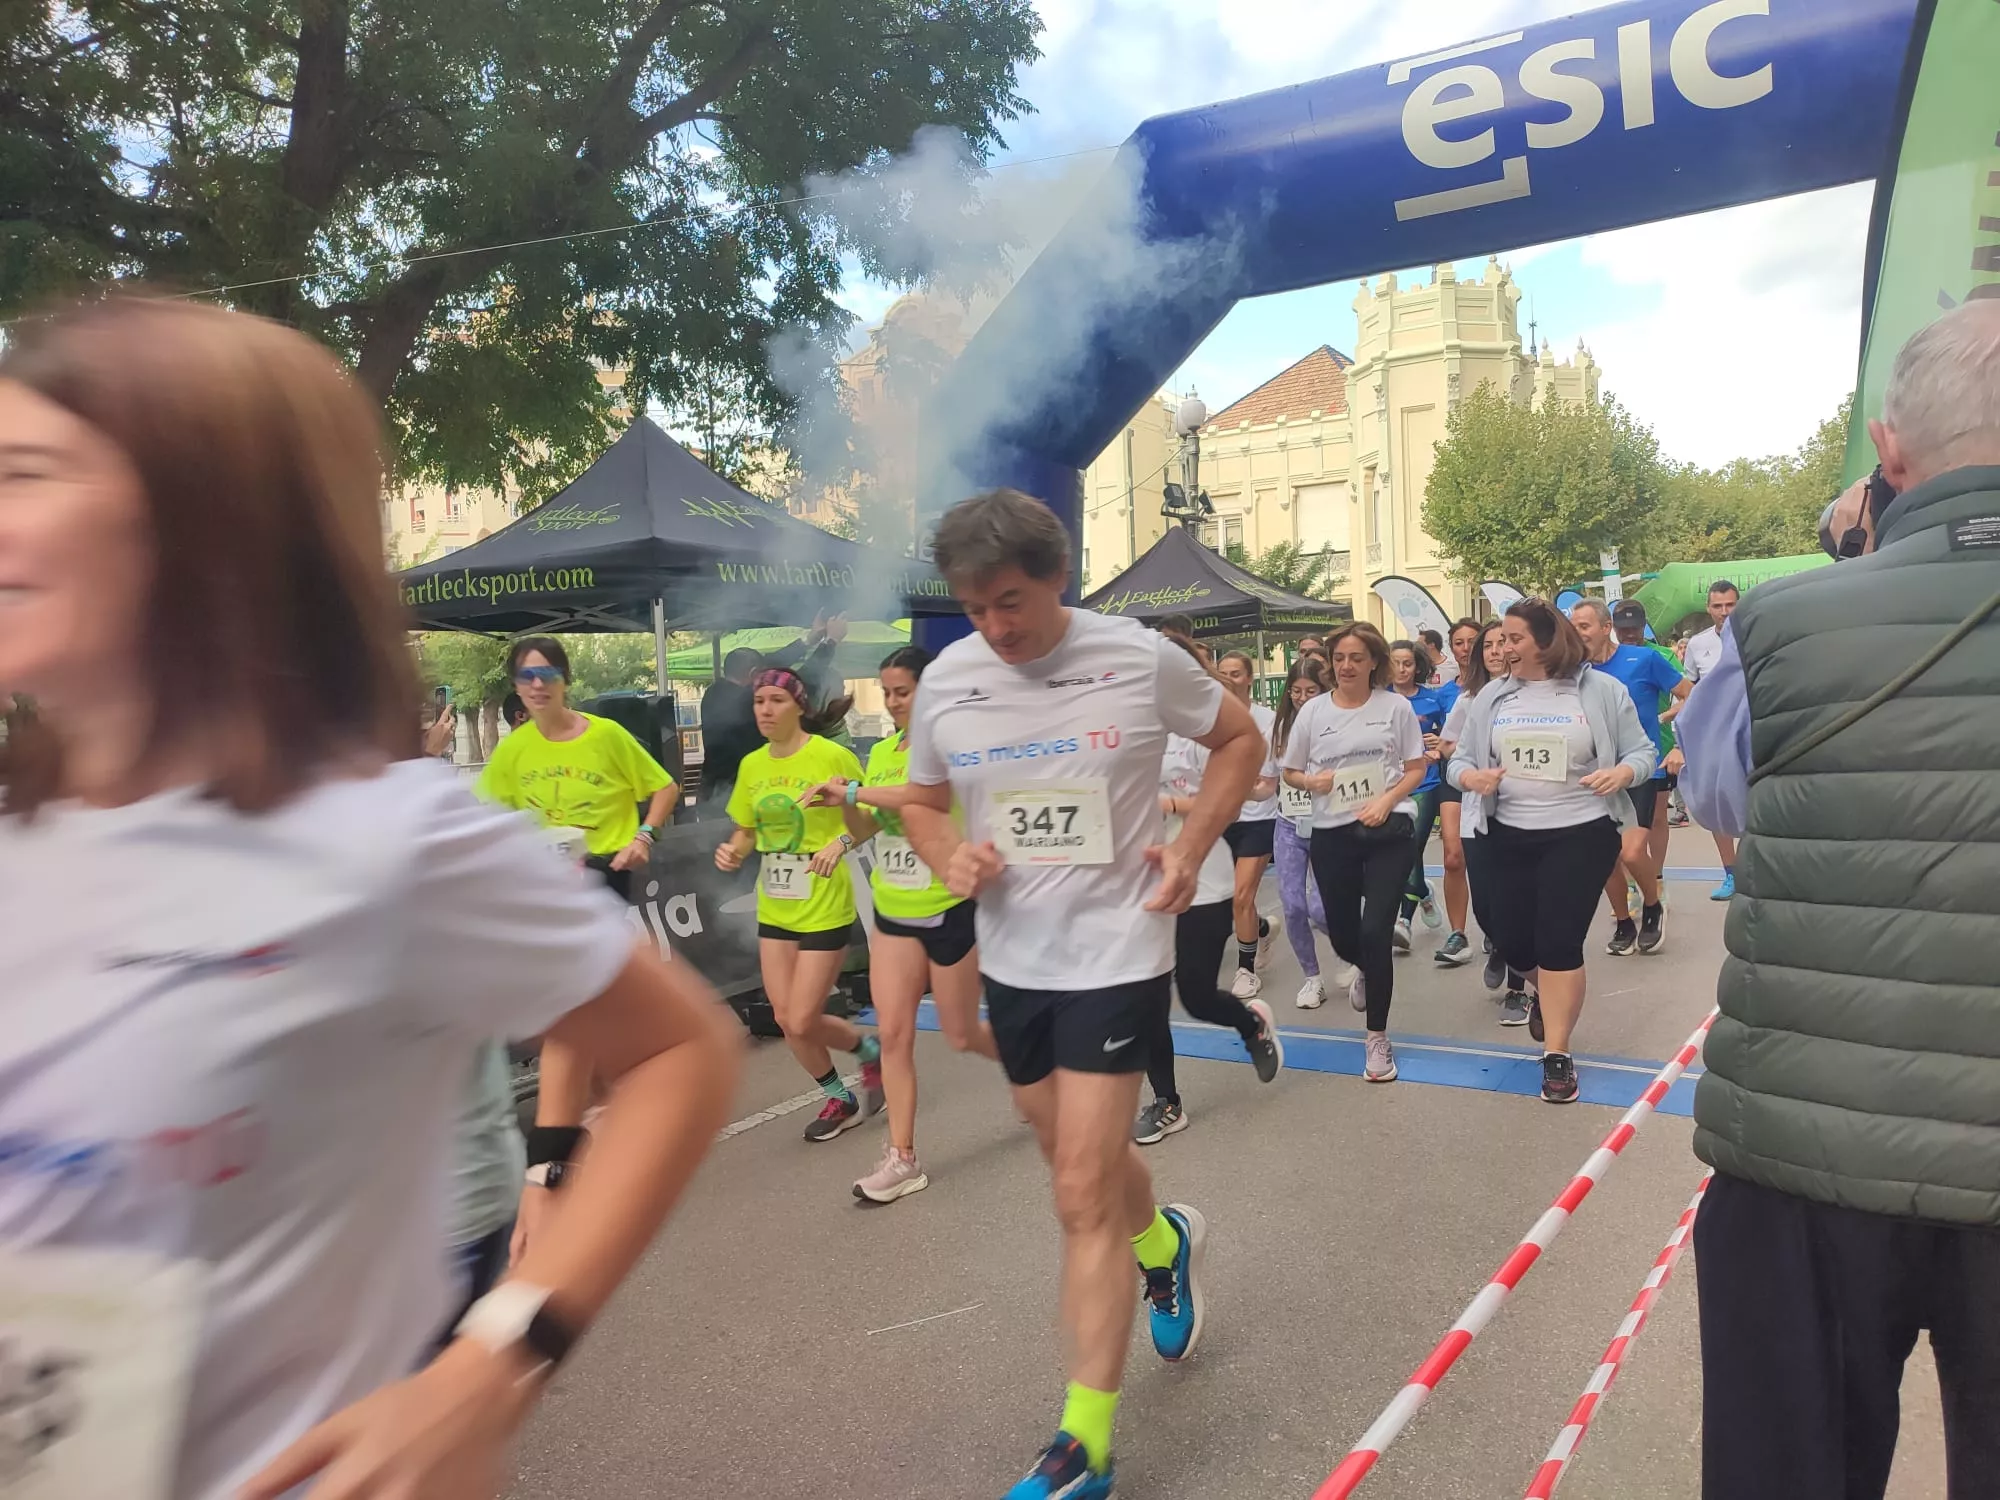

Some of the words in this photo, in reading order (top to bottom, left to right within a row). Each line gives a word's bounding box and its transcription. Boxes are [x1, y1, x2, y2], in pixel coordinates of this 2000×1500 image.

[1402, 0, 1773, 169] esic
[717, 558, 949, 597] www.fartlecort.com
[988, 738, 1079, 762] mueves
[1086, 725, 1121, 750] TÚ
[1512, 747, 1551, 764] 113
[1287, 790, 1312, 802] 114
[1337, 779, 1371, 797] 111
[1009, 806, 1080, 836] 347
[883, 850, 916, 868] 116
[766, 867, 794, 884] 117
